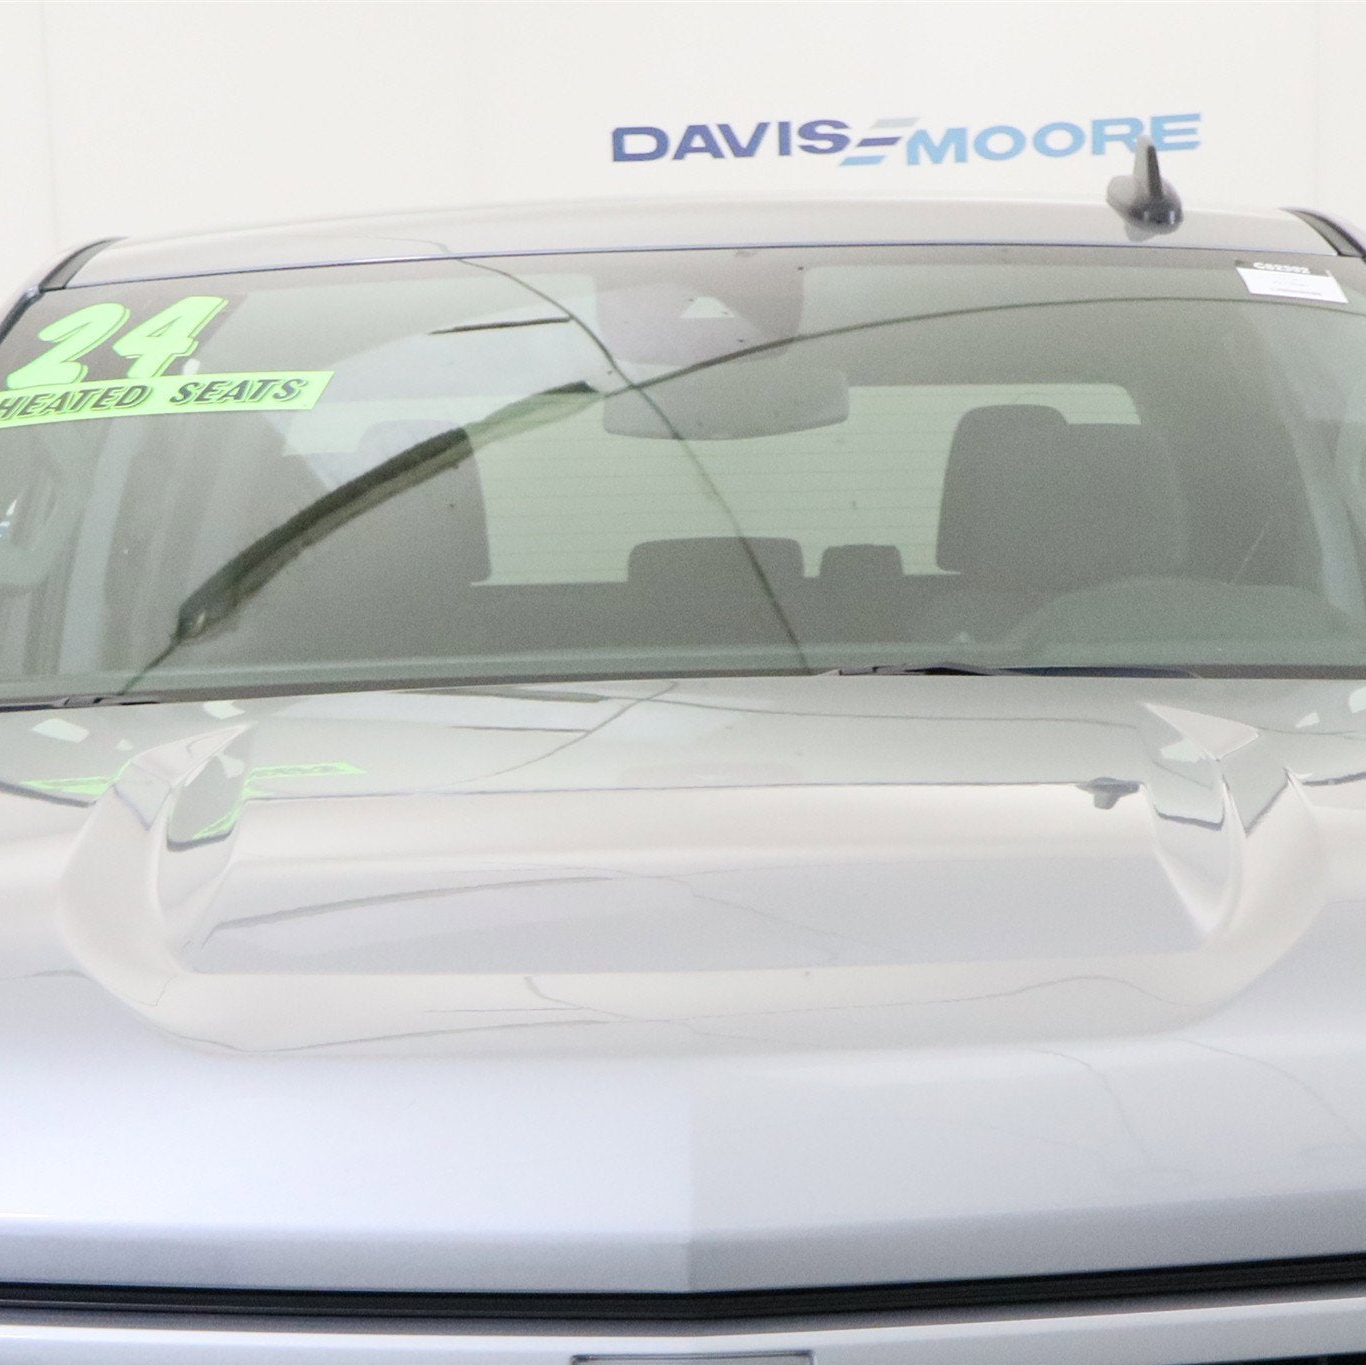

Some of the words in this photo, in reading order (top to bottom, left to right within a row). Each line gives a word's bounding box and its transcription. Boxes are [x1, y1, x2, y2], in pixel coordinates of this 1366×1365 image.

[611, 119, 855, 163] DAVIS
[906, 112, 1202, 166] MOORE
[5, 294, 230, 391] 24
[168, 376, 312, 407] SEATS
